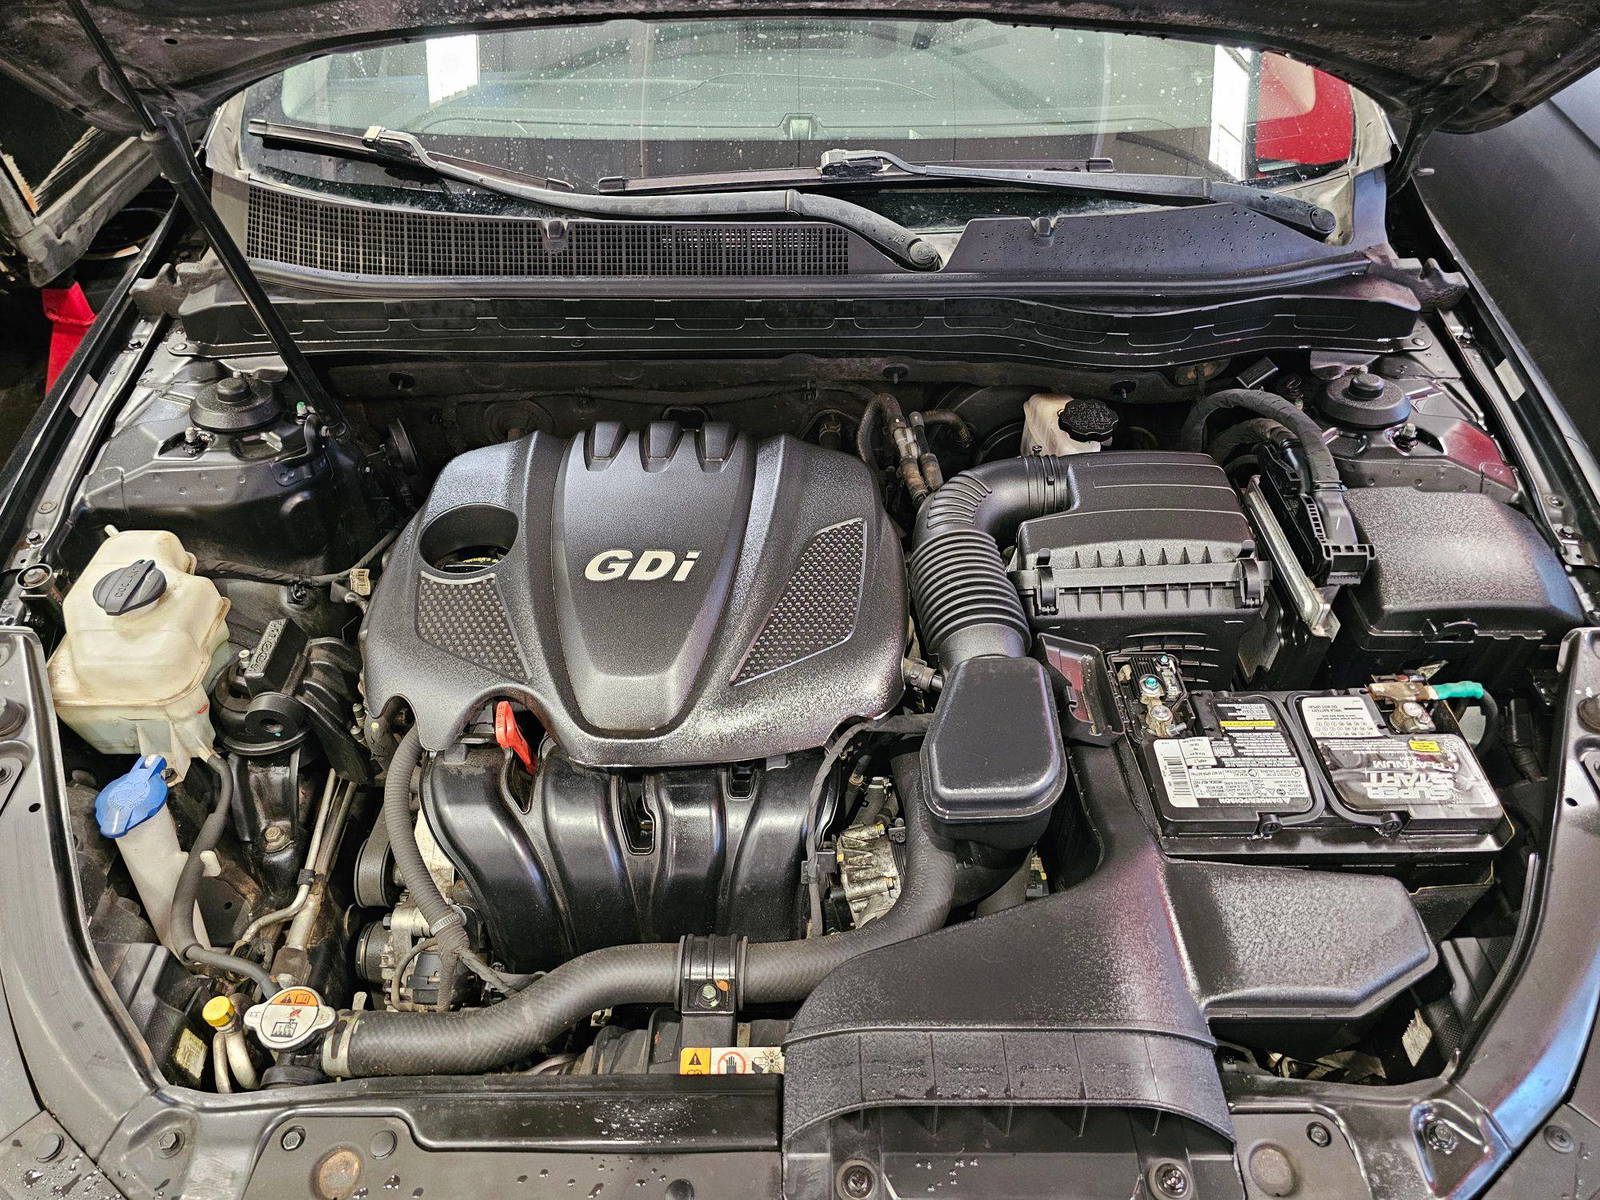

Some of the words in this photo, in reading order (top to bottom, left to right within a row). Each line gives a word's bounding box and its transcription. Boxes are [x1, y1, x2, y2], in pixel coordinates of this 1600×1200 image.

[584, 549, 702, 581] GDi
[1372, 760, 1444, 771] PLATINUM
[1360, 772, 1455, 787] START
[1367, 786, 1451, 801] SUPER
